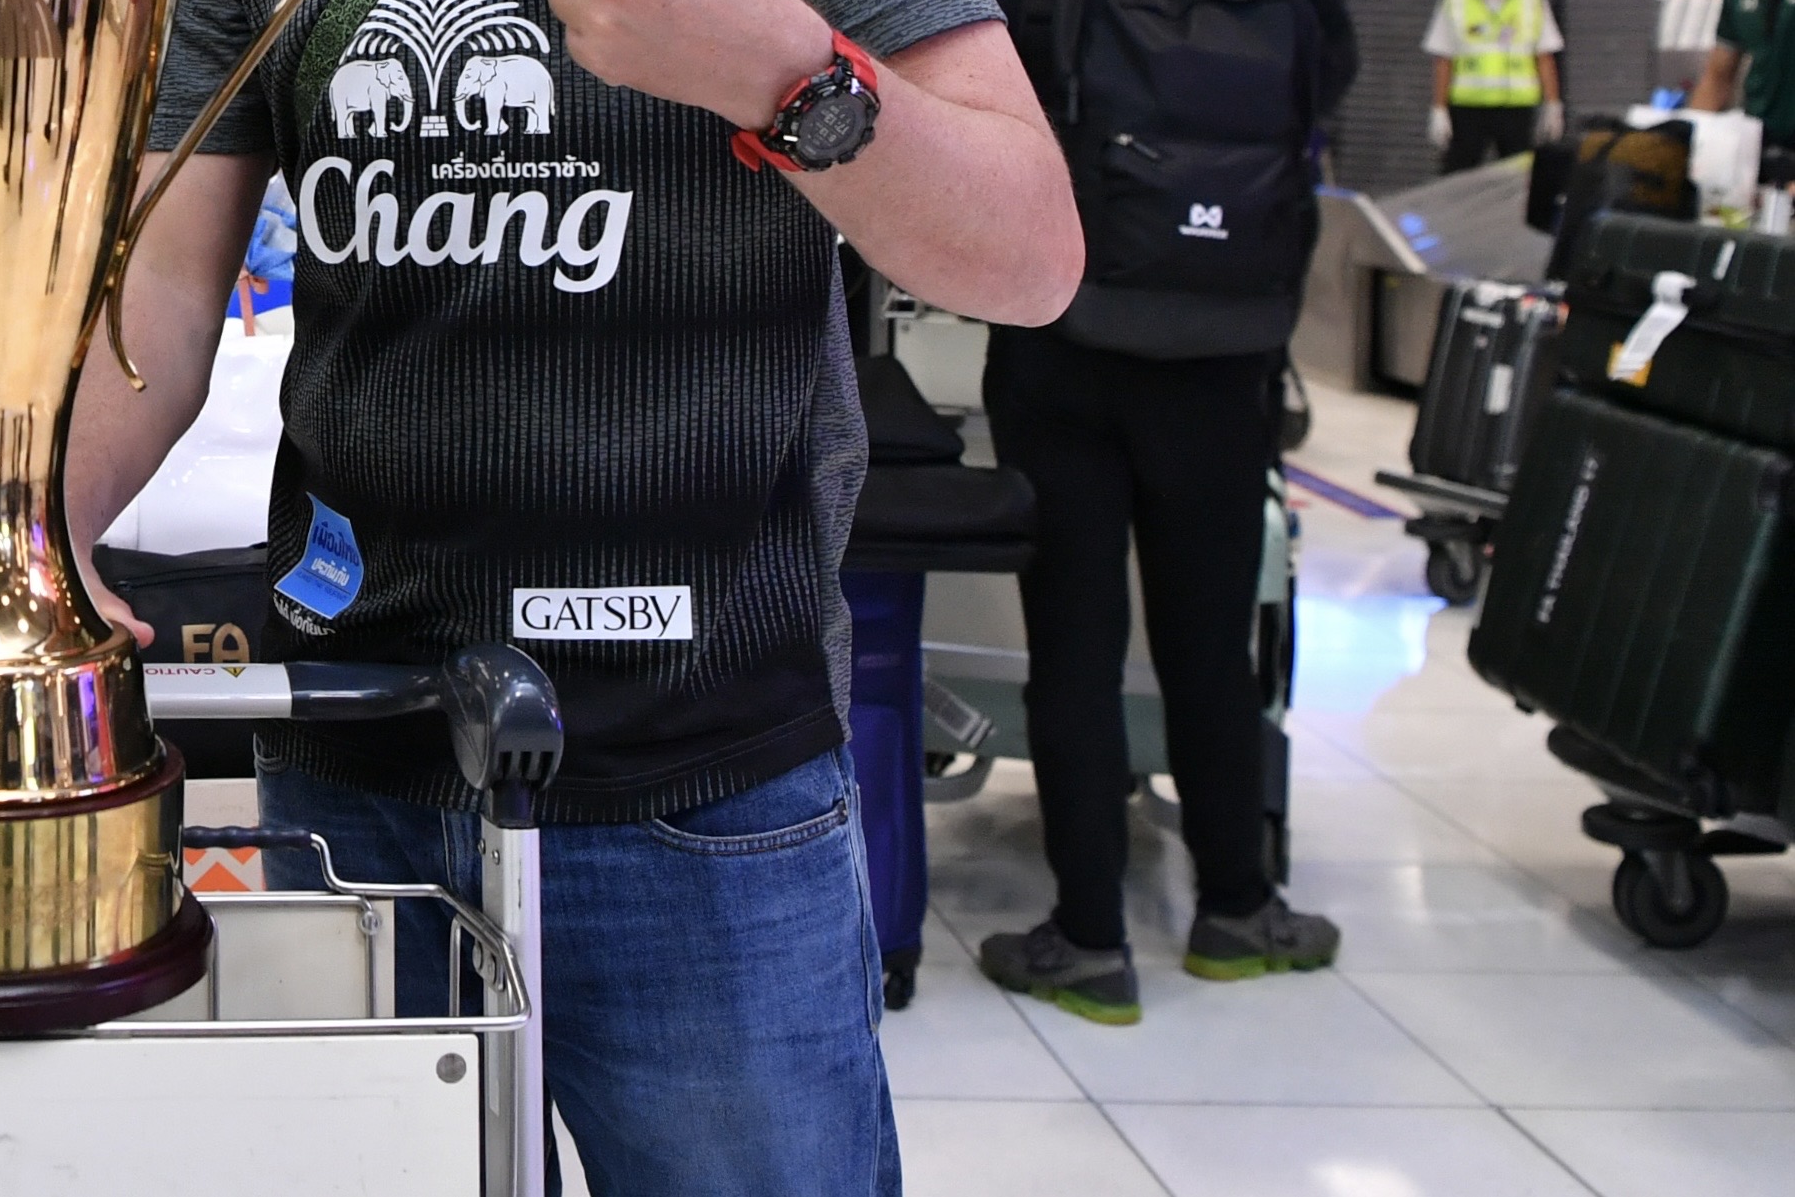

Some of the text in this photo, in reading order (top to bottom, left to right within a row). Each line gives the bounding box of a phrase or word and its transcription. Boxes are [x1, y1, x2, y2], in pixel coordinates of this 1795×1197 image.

[432, 151, 600, 180] เครื่องดื่มตราช้าง
[299, 156, 633, 293] Chang
[521, 595, 682, 637] GATSBY
